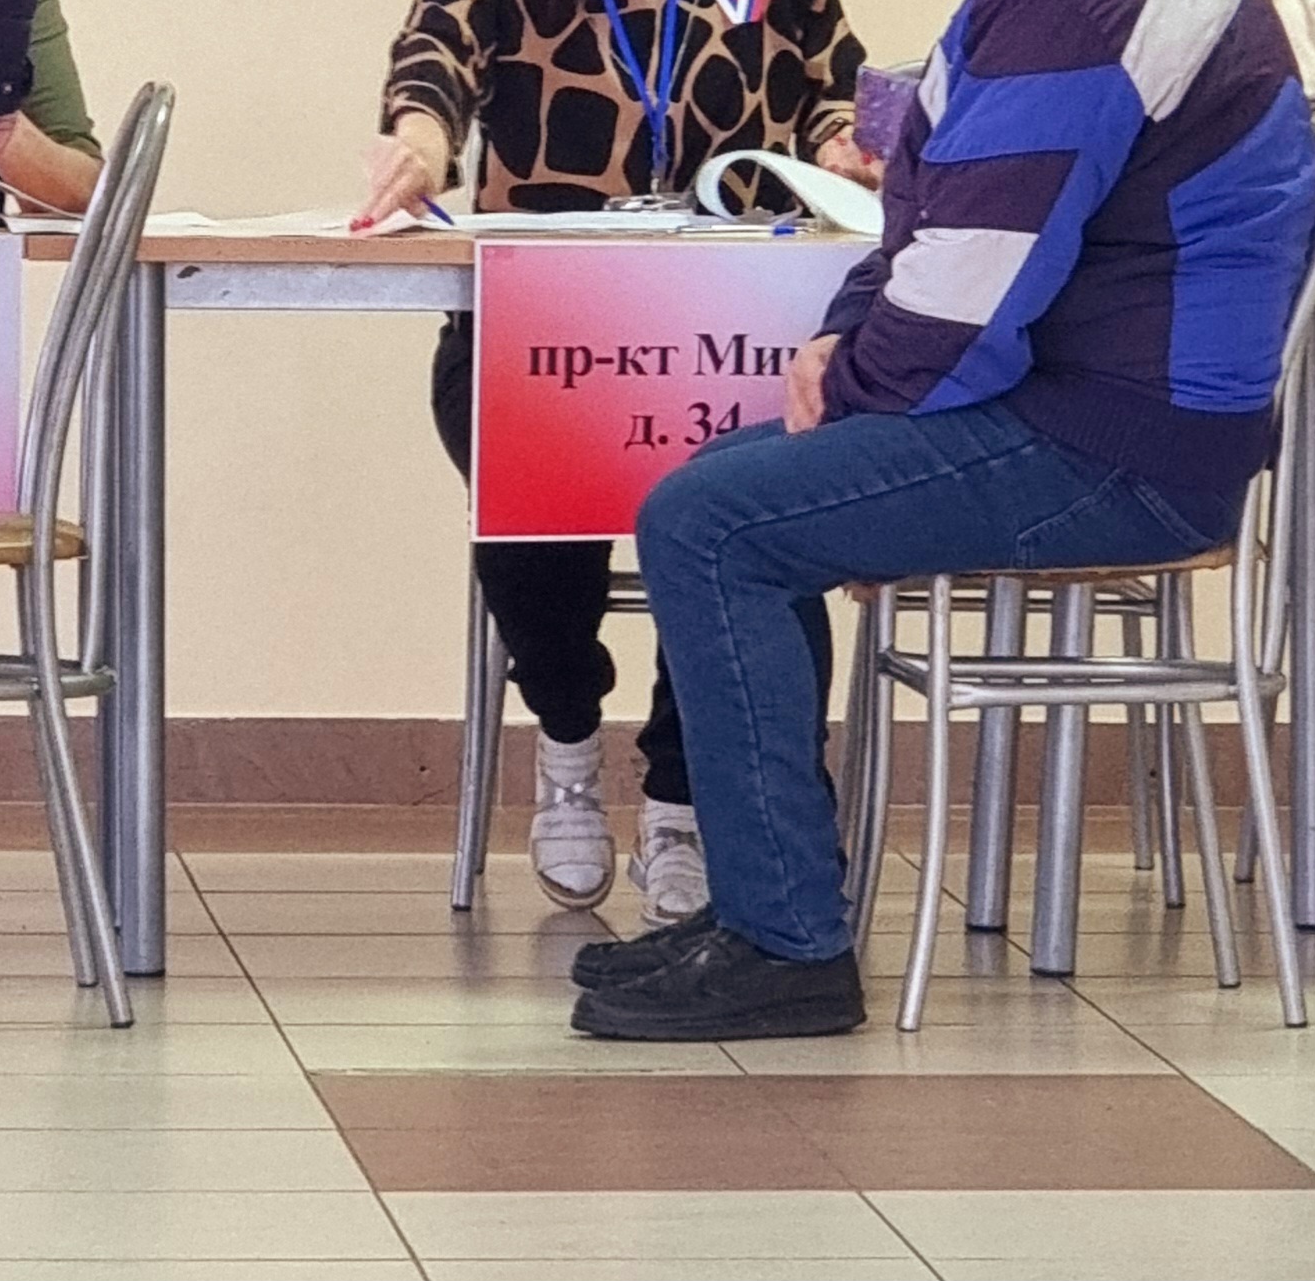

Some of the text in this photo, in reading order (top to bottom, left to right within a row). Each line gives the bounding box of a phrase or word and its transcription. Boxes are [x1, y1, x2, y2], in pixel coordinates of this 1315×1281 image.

[527, 333, 799, 389] пр-кт Ми
[624, 402, 741, 451] д. 34
